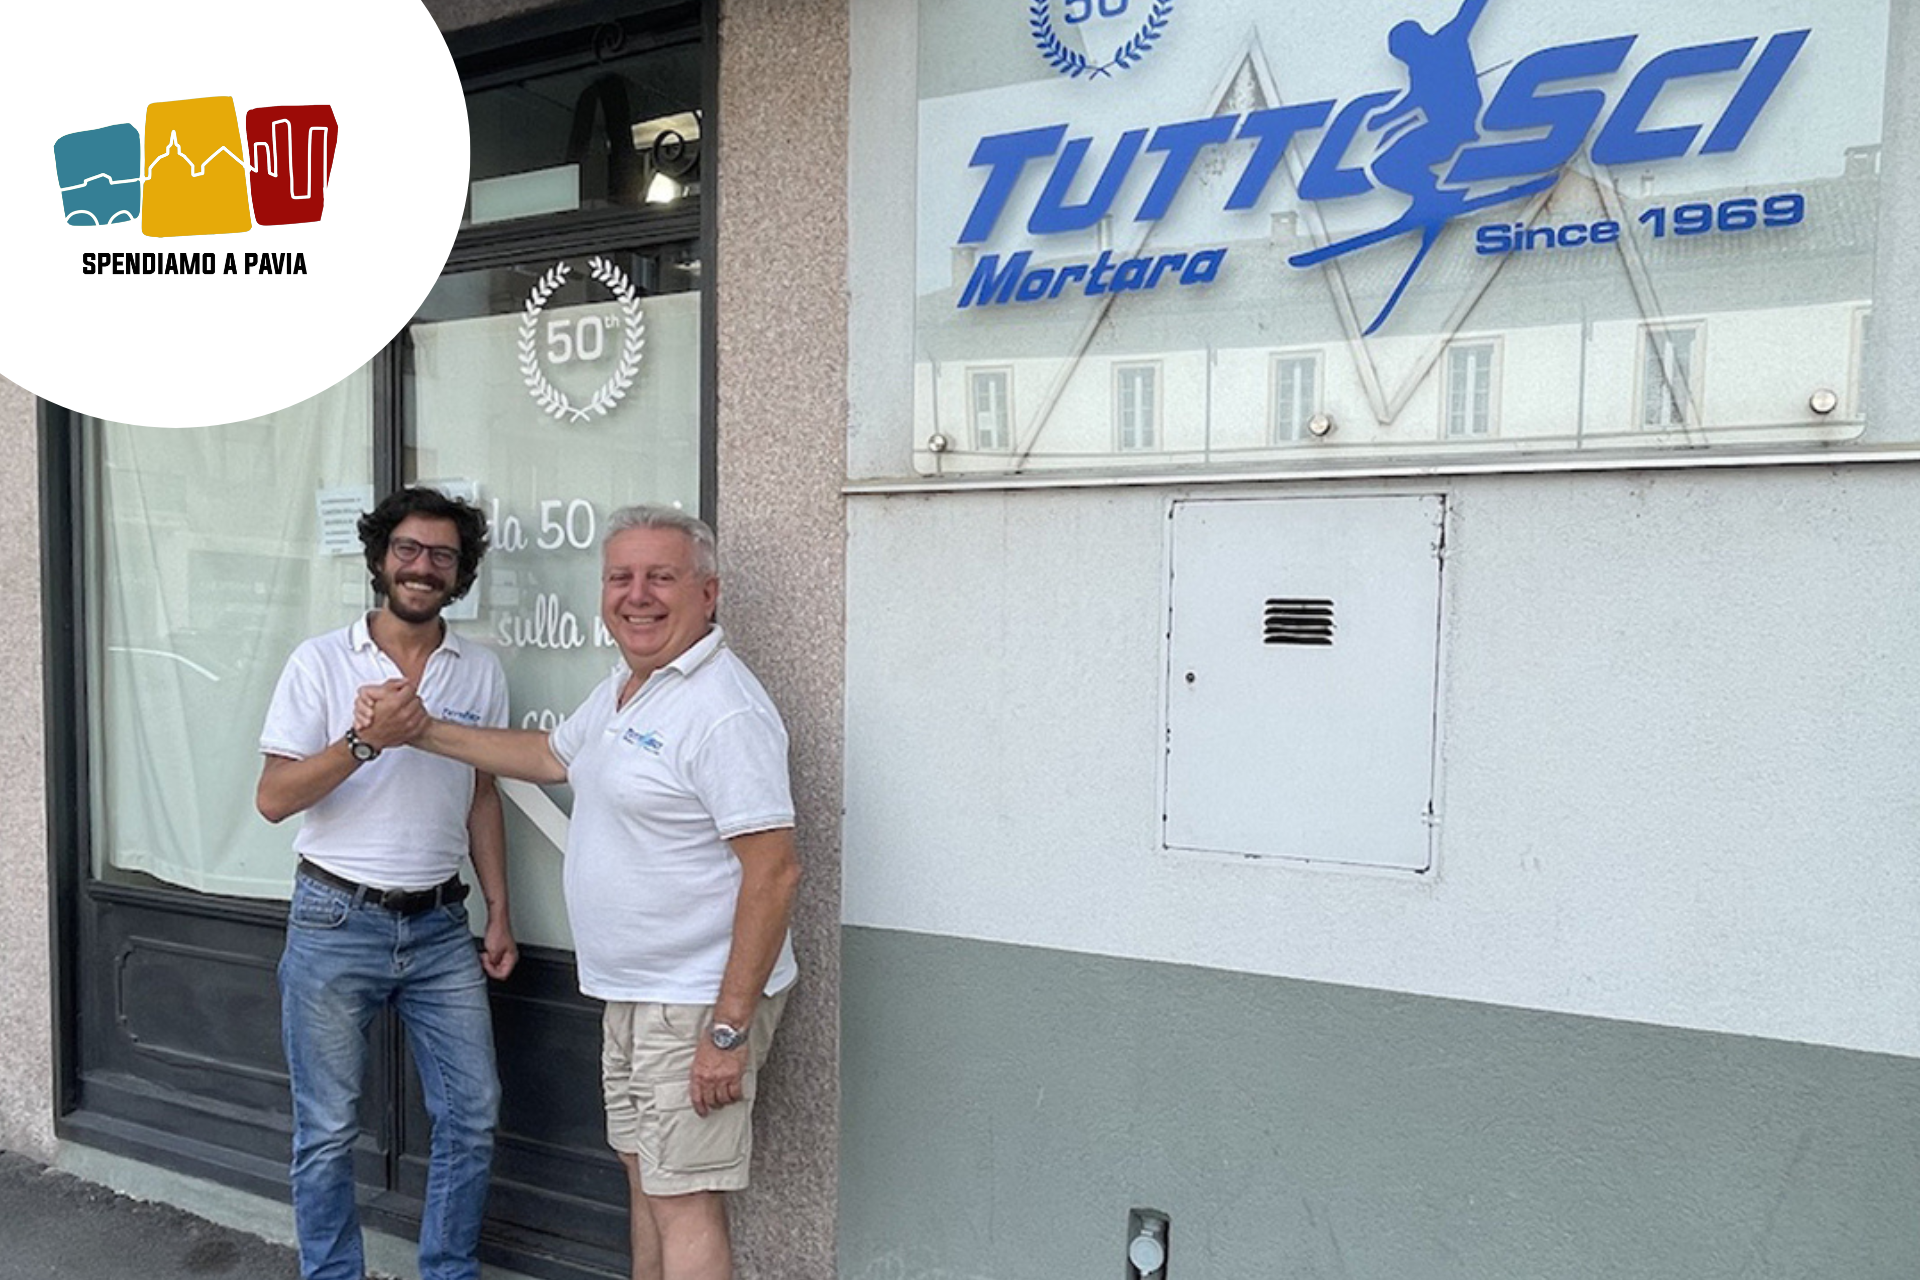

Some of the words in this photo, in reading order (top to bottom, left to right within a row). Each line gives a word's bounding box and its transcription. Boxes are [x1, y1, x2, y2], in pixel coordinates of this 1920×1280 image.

[1475, 220, 1620, 256] Since
[1638, 194, 1806, 238] 1969
[956, 248, 1228, 308] Mortara
[537, 499, 596, 549] 50
[498, 592, 585, 649] sulla
